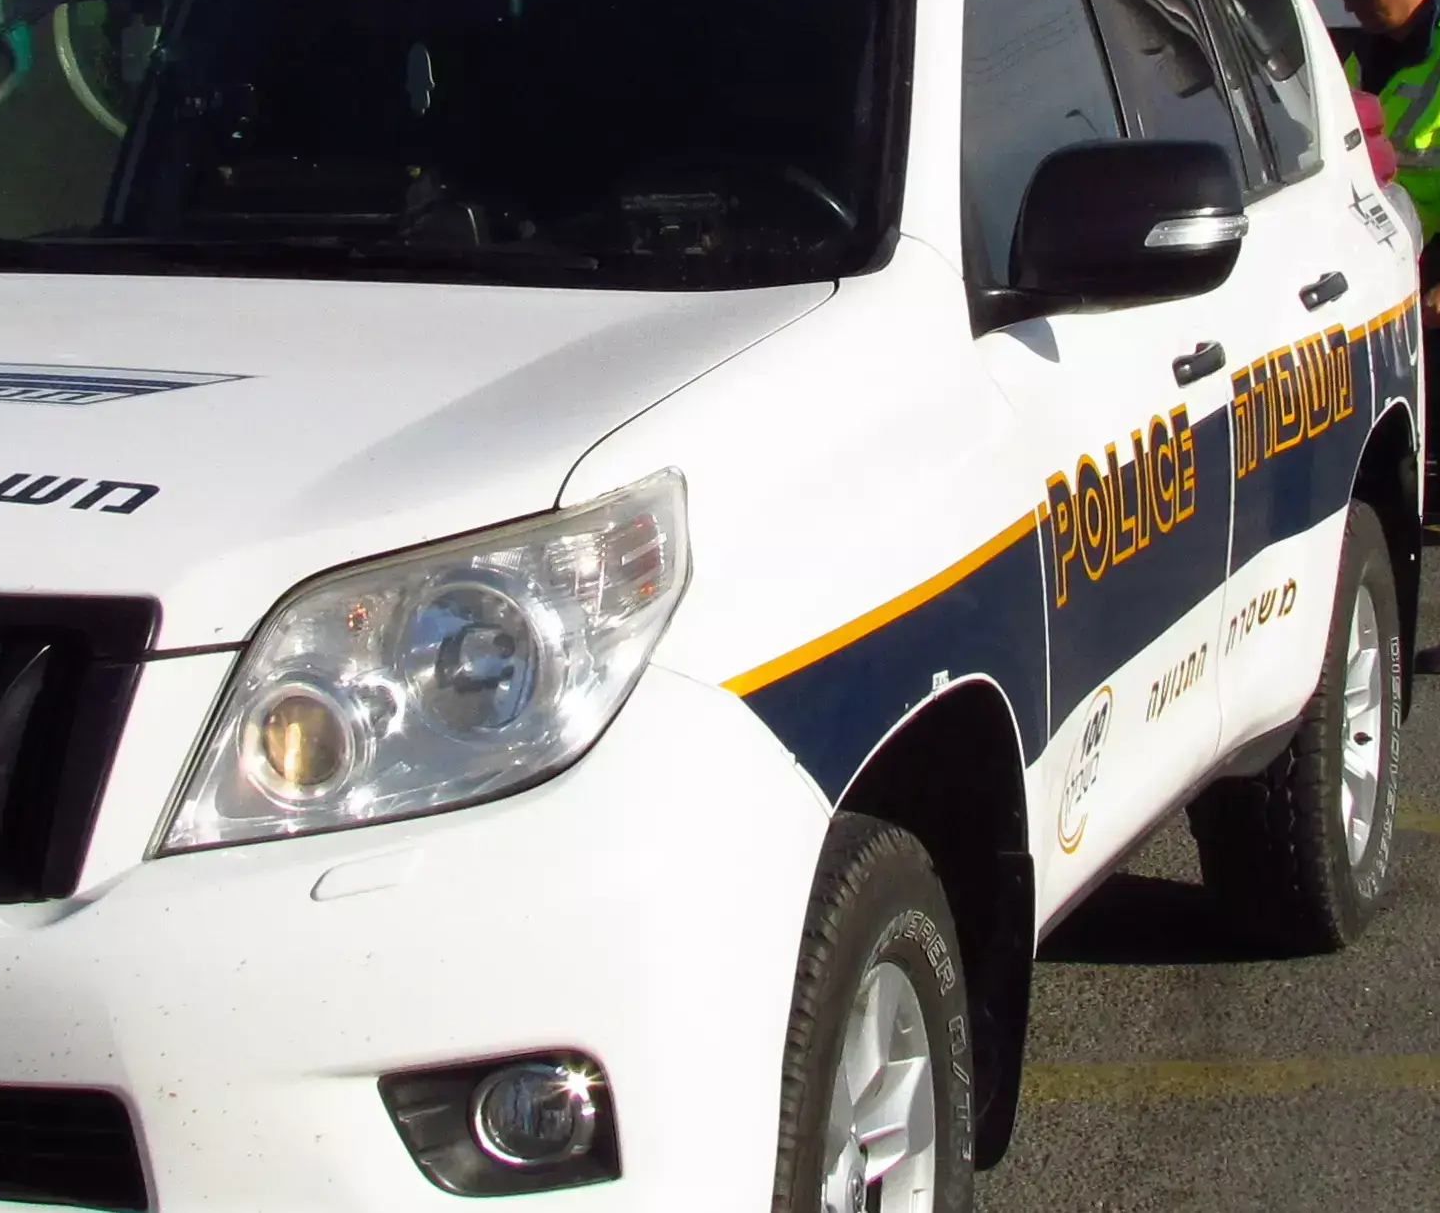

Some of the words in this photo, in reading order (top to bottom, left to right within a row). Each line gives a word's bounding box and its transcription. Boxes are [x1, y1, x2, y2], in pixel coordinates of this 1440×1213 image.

[1231, 323, 1353, 479] משטרה
[1046, 402, 1195, 608] POLICE
[1080, 702, 1108, 763] 100
[1146, 642, 1208, 722] התנועה
